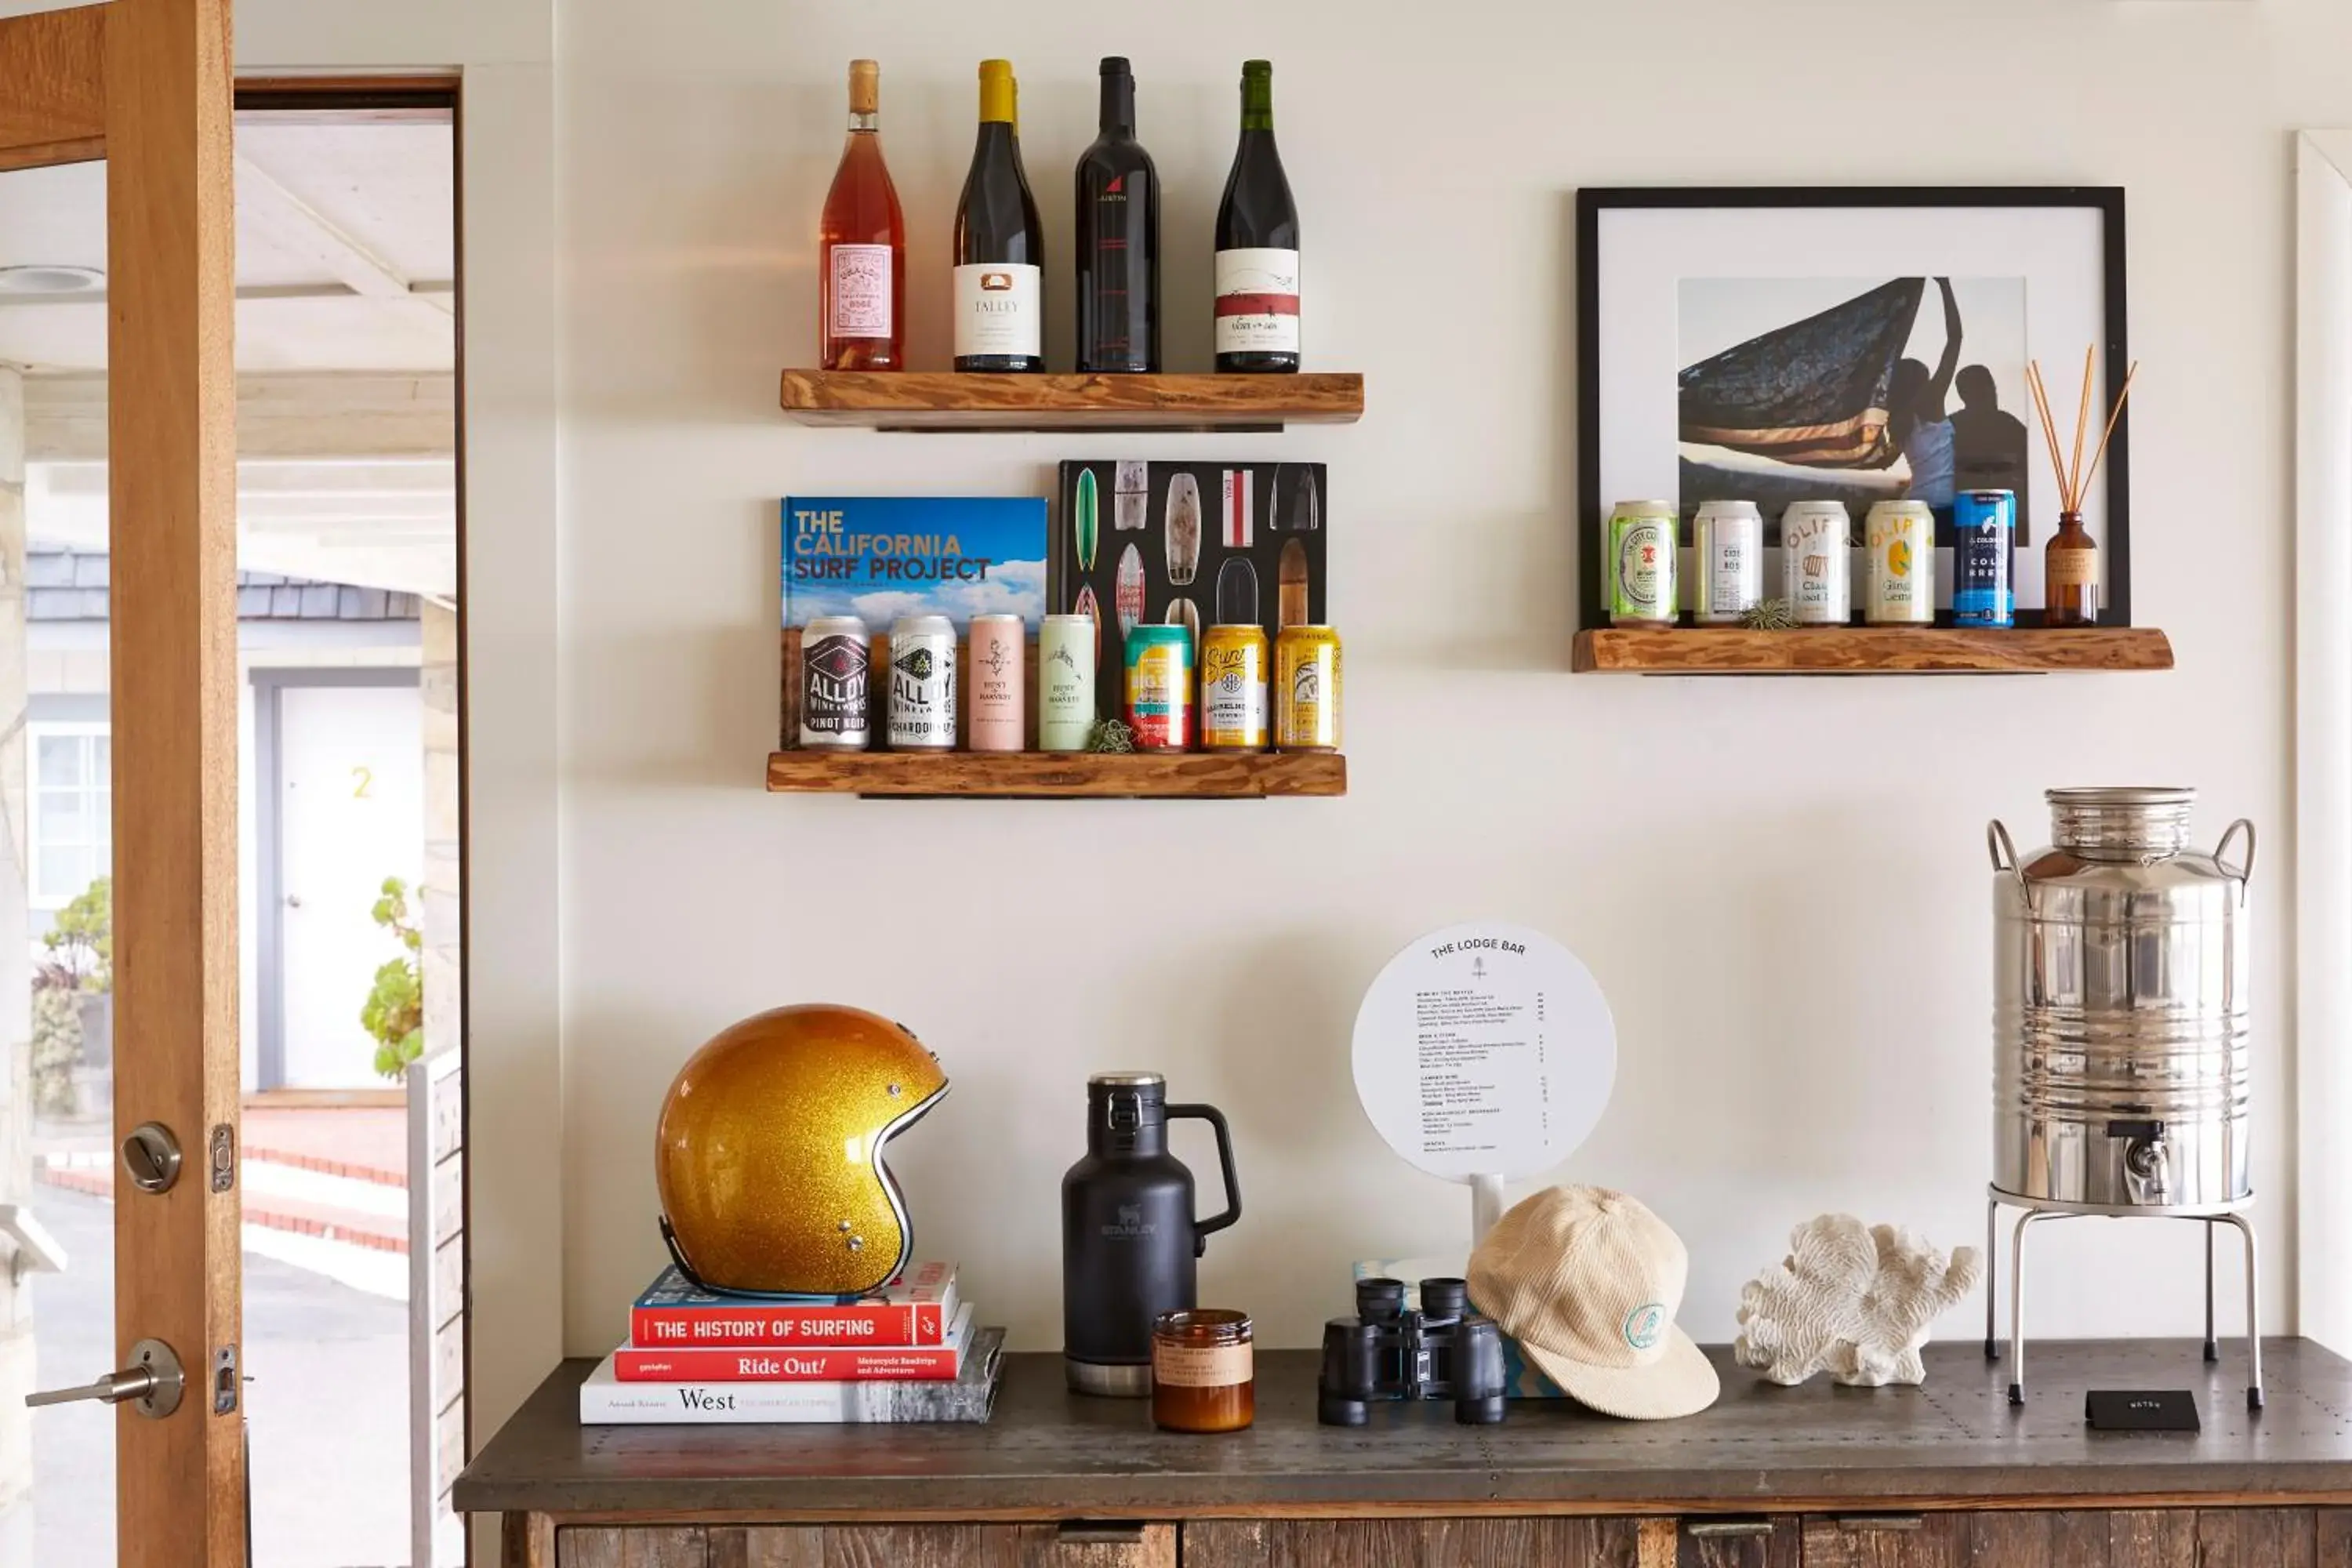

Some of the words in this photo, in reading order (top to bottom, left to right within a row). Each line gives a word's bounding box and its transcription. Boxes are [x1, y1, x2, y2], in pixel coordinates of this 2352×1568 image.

[975, 300, 1018, 313] TALLEY
[794, 510, 844, 533] THE
[794, 534, 962, 556] CALIFORNIA
[794, 557, 859, 579] SURF
[869, 557, 992, 580] PROJECT
[810, 671, 866, 703] ALLOY
[811, 717, 840, 730] PINOT
[844, 717, 866, 730] NOIR
[351, 766, 374, 799] 2
[1432, 943, 1454, 959] THE
[1457, 938, 1498, 951] LODGE
[1501, 940, 1526, 956] BAR
[654, 1321, 688, 1338] THE
[694, 1320, 766, 1338] HISTORY
[772, 1320, 794, 1337] OF
[800, 1319, 875, 1337] SURFING
[739, 1357, 780, 1375] Ride
[784, 1357, 827, 1375] Out!
[857, 1356, 899, 1367] Motorcycle
[873, 1367, 915, 1375] Adventures
[677, 1388, 736, 1411] West
